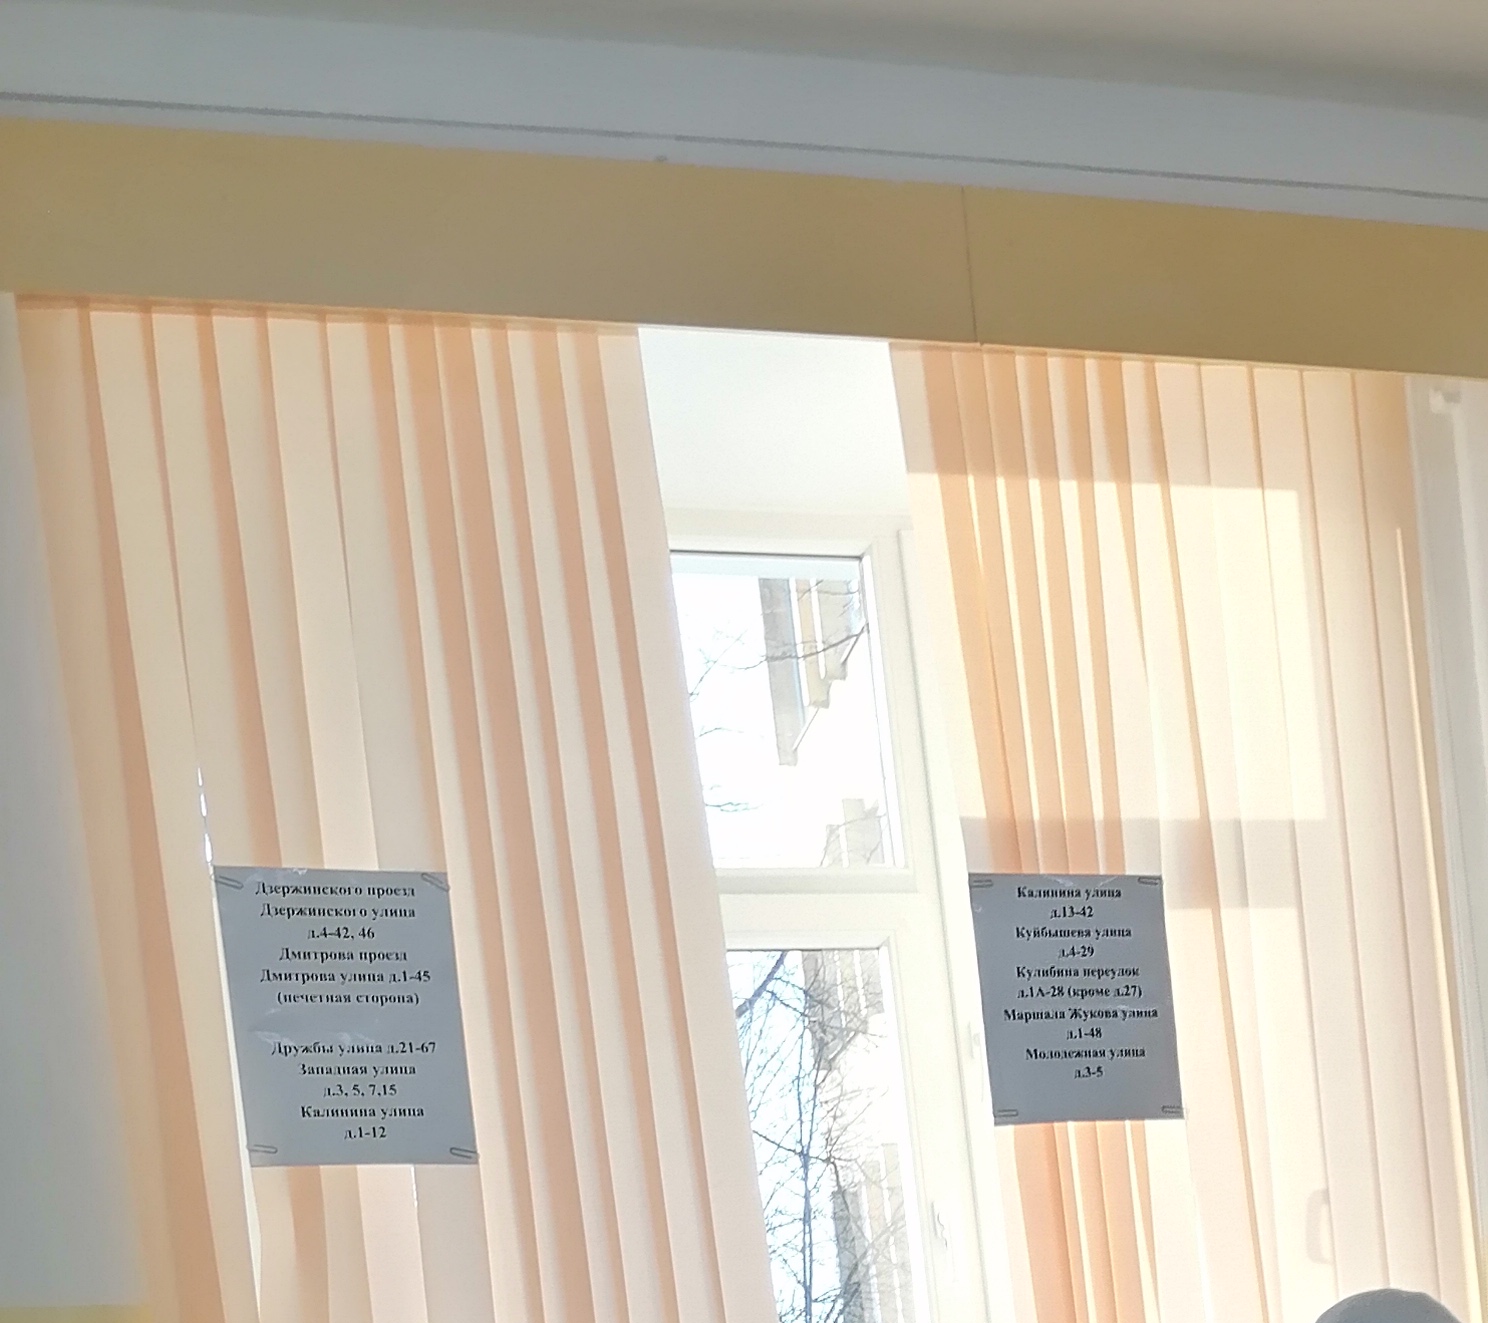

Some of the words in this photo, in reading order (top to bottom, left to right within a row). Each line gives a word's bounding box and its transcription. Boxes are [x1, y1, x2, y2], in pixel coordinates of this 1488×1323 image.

[255, 882, 362, 897] Дзержинского
[368, 887, 415, 899] проезд
[1018, 886, 1081, 898] Калинина
[1085, 889, 1121, 900] улица
[260, 903, 367, 919] Дзержинского
[372, 908, 415, 920] улица
[1050, 906, 1094, 919] д.13-42
[358, 927, 374, 939] 46
[1016, 927, 1091, 941] Куйбышева
[1095, 928, 1131, 940] улица
[279, 948, 354, 963] Дмитрова
[359, 952, 407, 963] проезд
[1058, 945, 1094, 958] д.4-29
[260, 969, 335, 984] Дмитрова
[340, 973, 384, 985] улица
[389, 970, 430, 983] д.1-45
[1016, 965, 1079, 981] Кулибина
[1083, 968, 1140, 980] переулок
[278, 992, 351, 1004] (нечетная
[356, 993, 419, 1006] сторона)
[1068, 986, 1110, 1000] (кроме
[1113, 985, 1142, 998] д.27)
[1004, 1009, 1065, 1023] Маршала
[1068, 1008, 1118, 1021] Жукова
[1121, 1009, 1158, 1021] улица
[1067, 1027, 1102, 1039] д.1-48
[271, 1042, 333, 1057] Дружбы
[338, 1045, 382, 1056] улица
[387, 1042, 436, 1054] д.21-67
[1026, 1048, 1105, 1060] Молодежная
[1109, 1049, 1145, 1060] улица
[298, 1063, 367, 1075] Западная
[373, 1066, 416, 1077] улица
[1074, 1066, 1103, 1079] д.3-5
[301, 1106, 376, 1117] Калинина
[381, 1108, 424, 1120] улица
[344, 1126, 386, 1139] д.1-12
